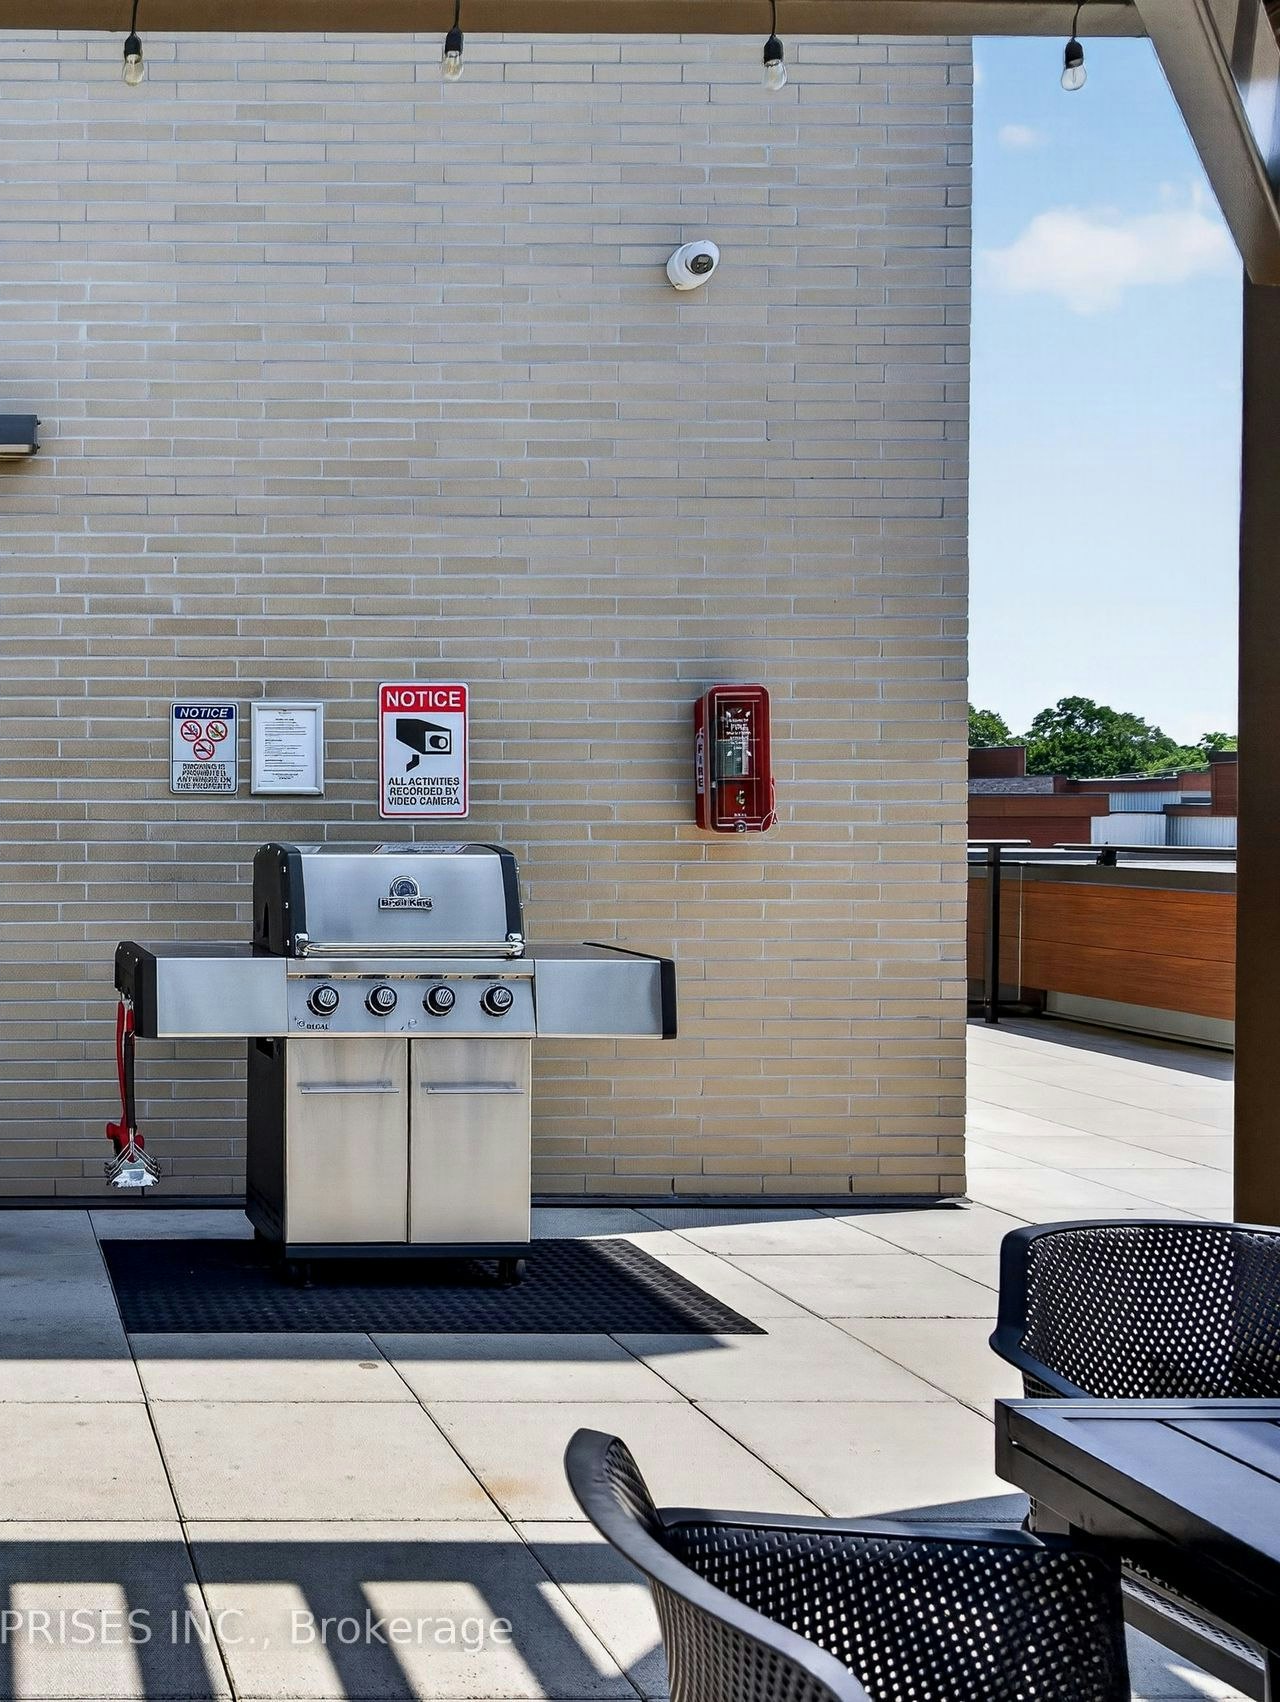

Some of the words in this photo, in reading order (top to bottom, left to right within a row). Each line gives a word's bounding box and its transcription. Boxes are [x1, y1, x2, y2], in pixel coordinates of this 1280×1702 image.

[386, 690, 461, 707] NOTICE
[180, 708, 229, 718] NOTICE
[388, 777, 407, 786] ALL
[408, 777, 460, 786] ACTIVITIES
[389, 787, 443, 796] RECORDED
[445, 787, 459, 796] BY
[387, 797, 417, 805] VIDEO
[419, 797, 461, 805] CAMERA
